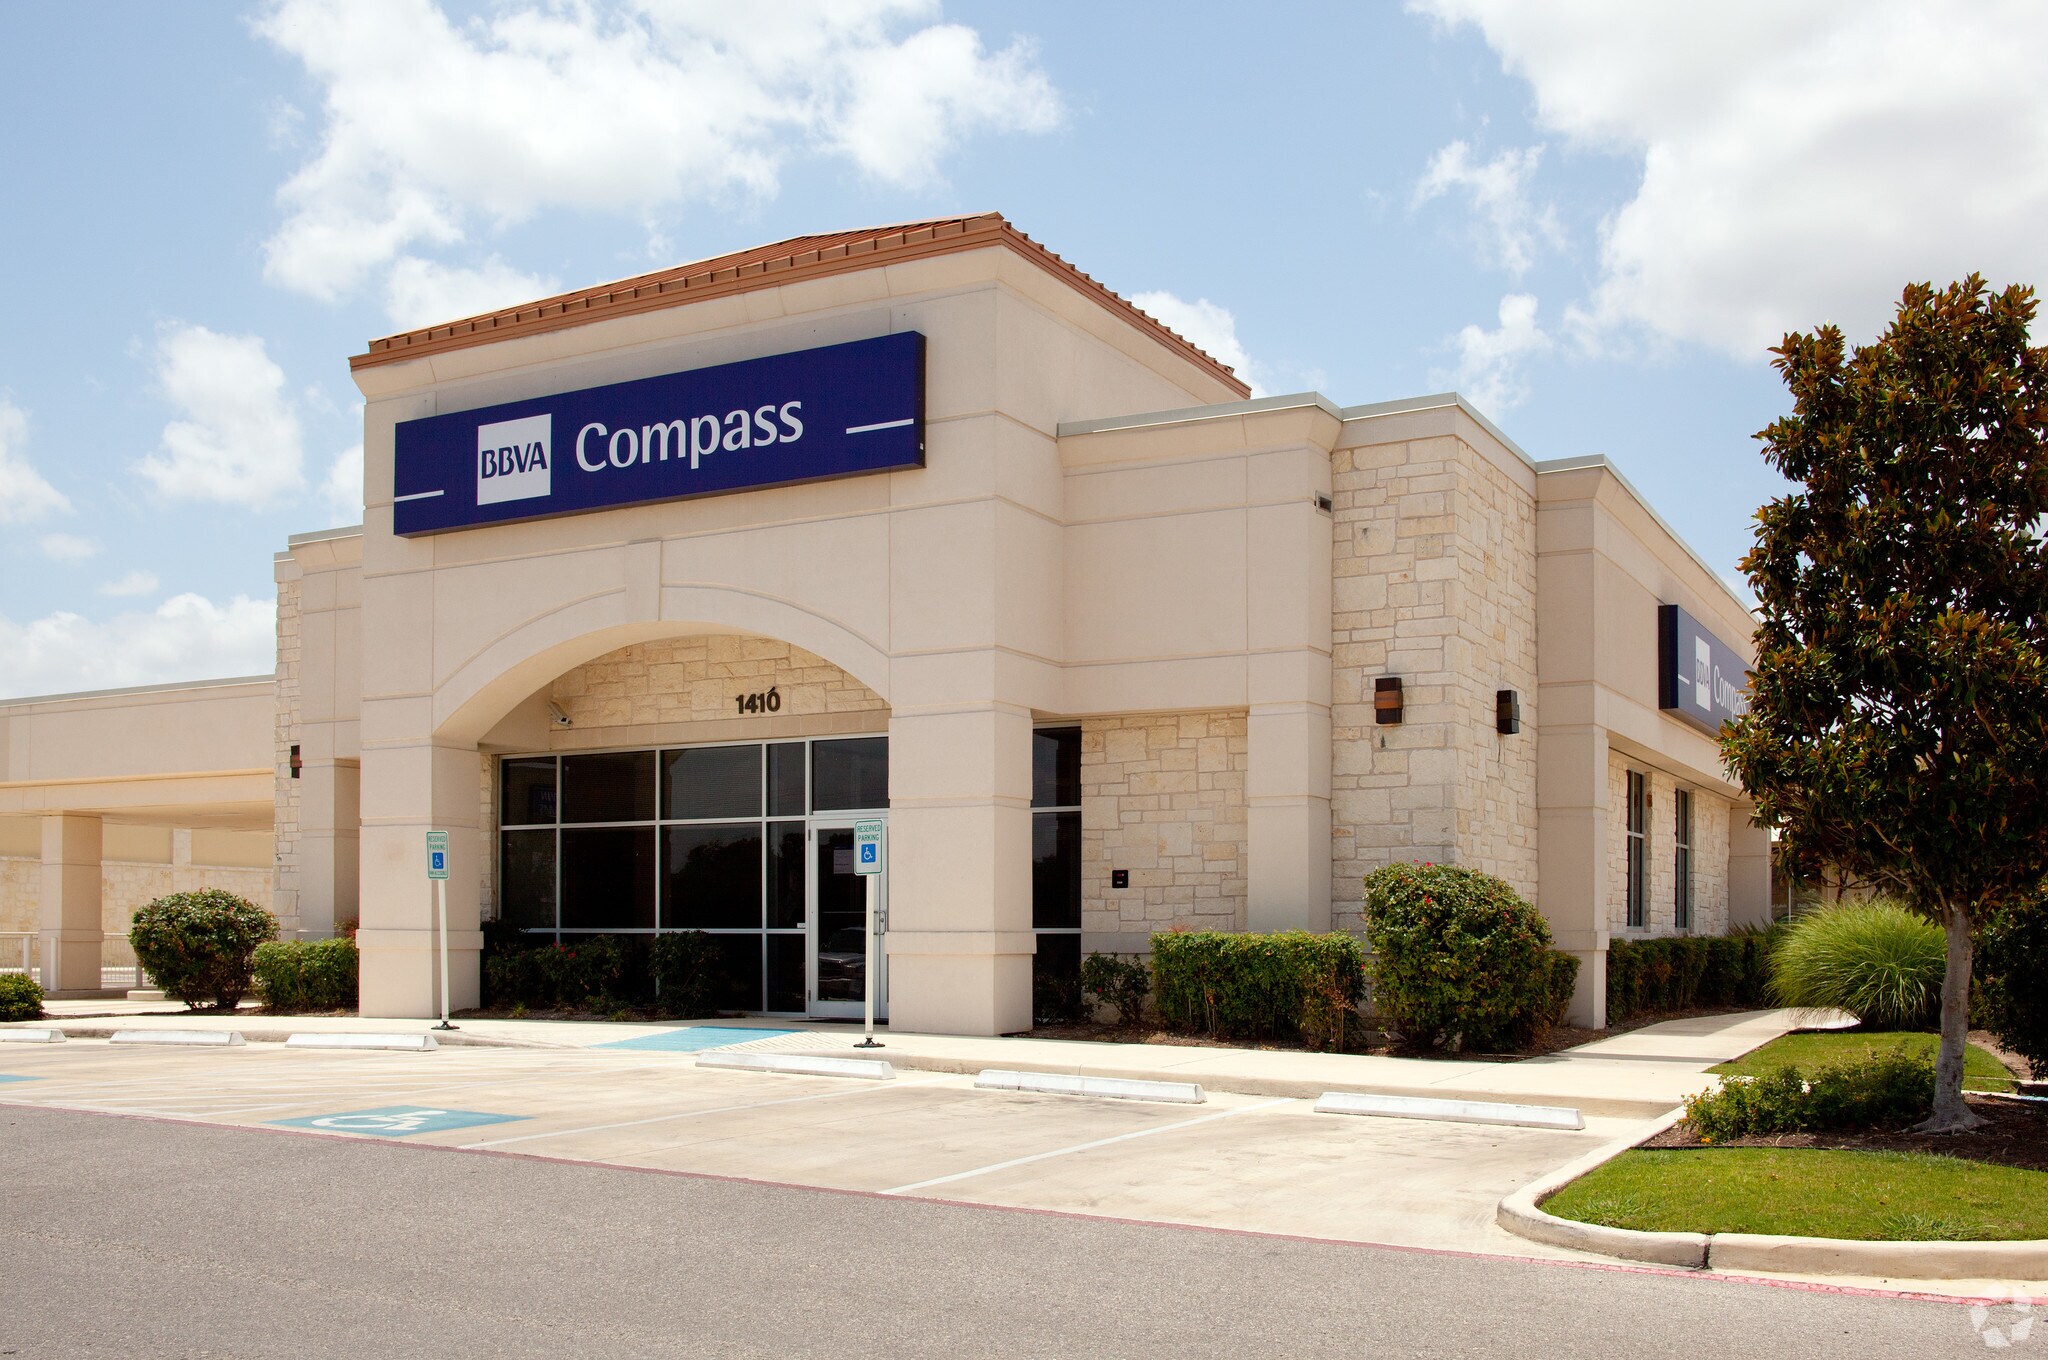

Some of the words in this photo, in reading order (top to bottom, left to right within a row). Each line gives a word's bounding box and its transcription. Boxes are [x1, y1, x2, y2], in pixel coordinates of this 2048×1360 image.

[481, 441, 548, 480] BBVA
[575, 400, 804, 473] Compass
[735, 691, 781, 714] 1410
